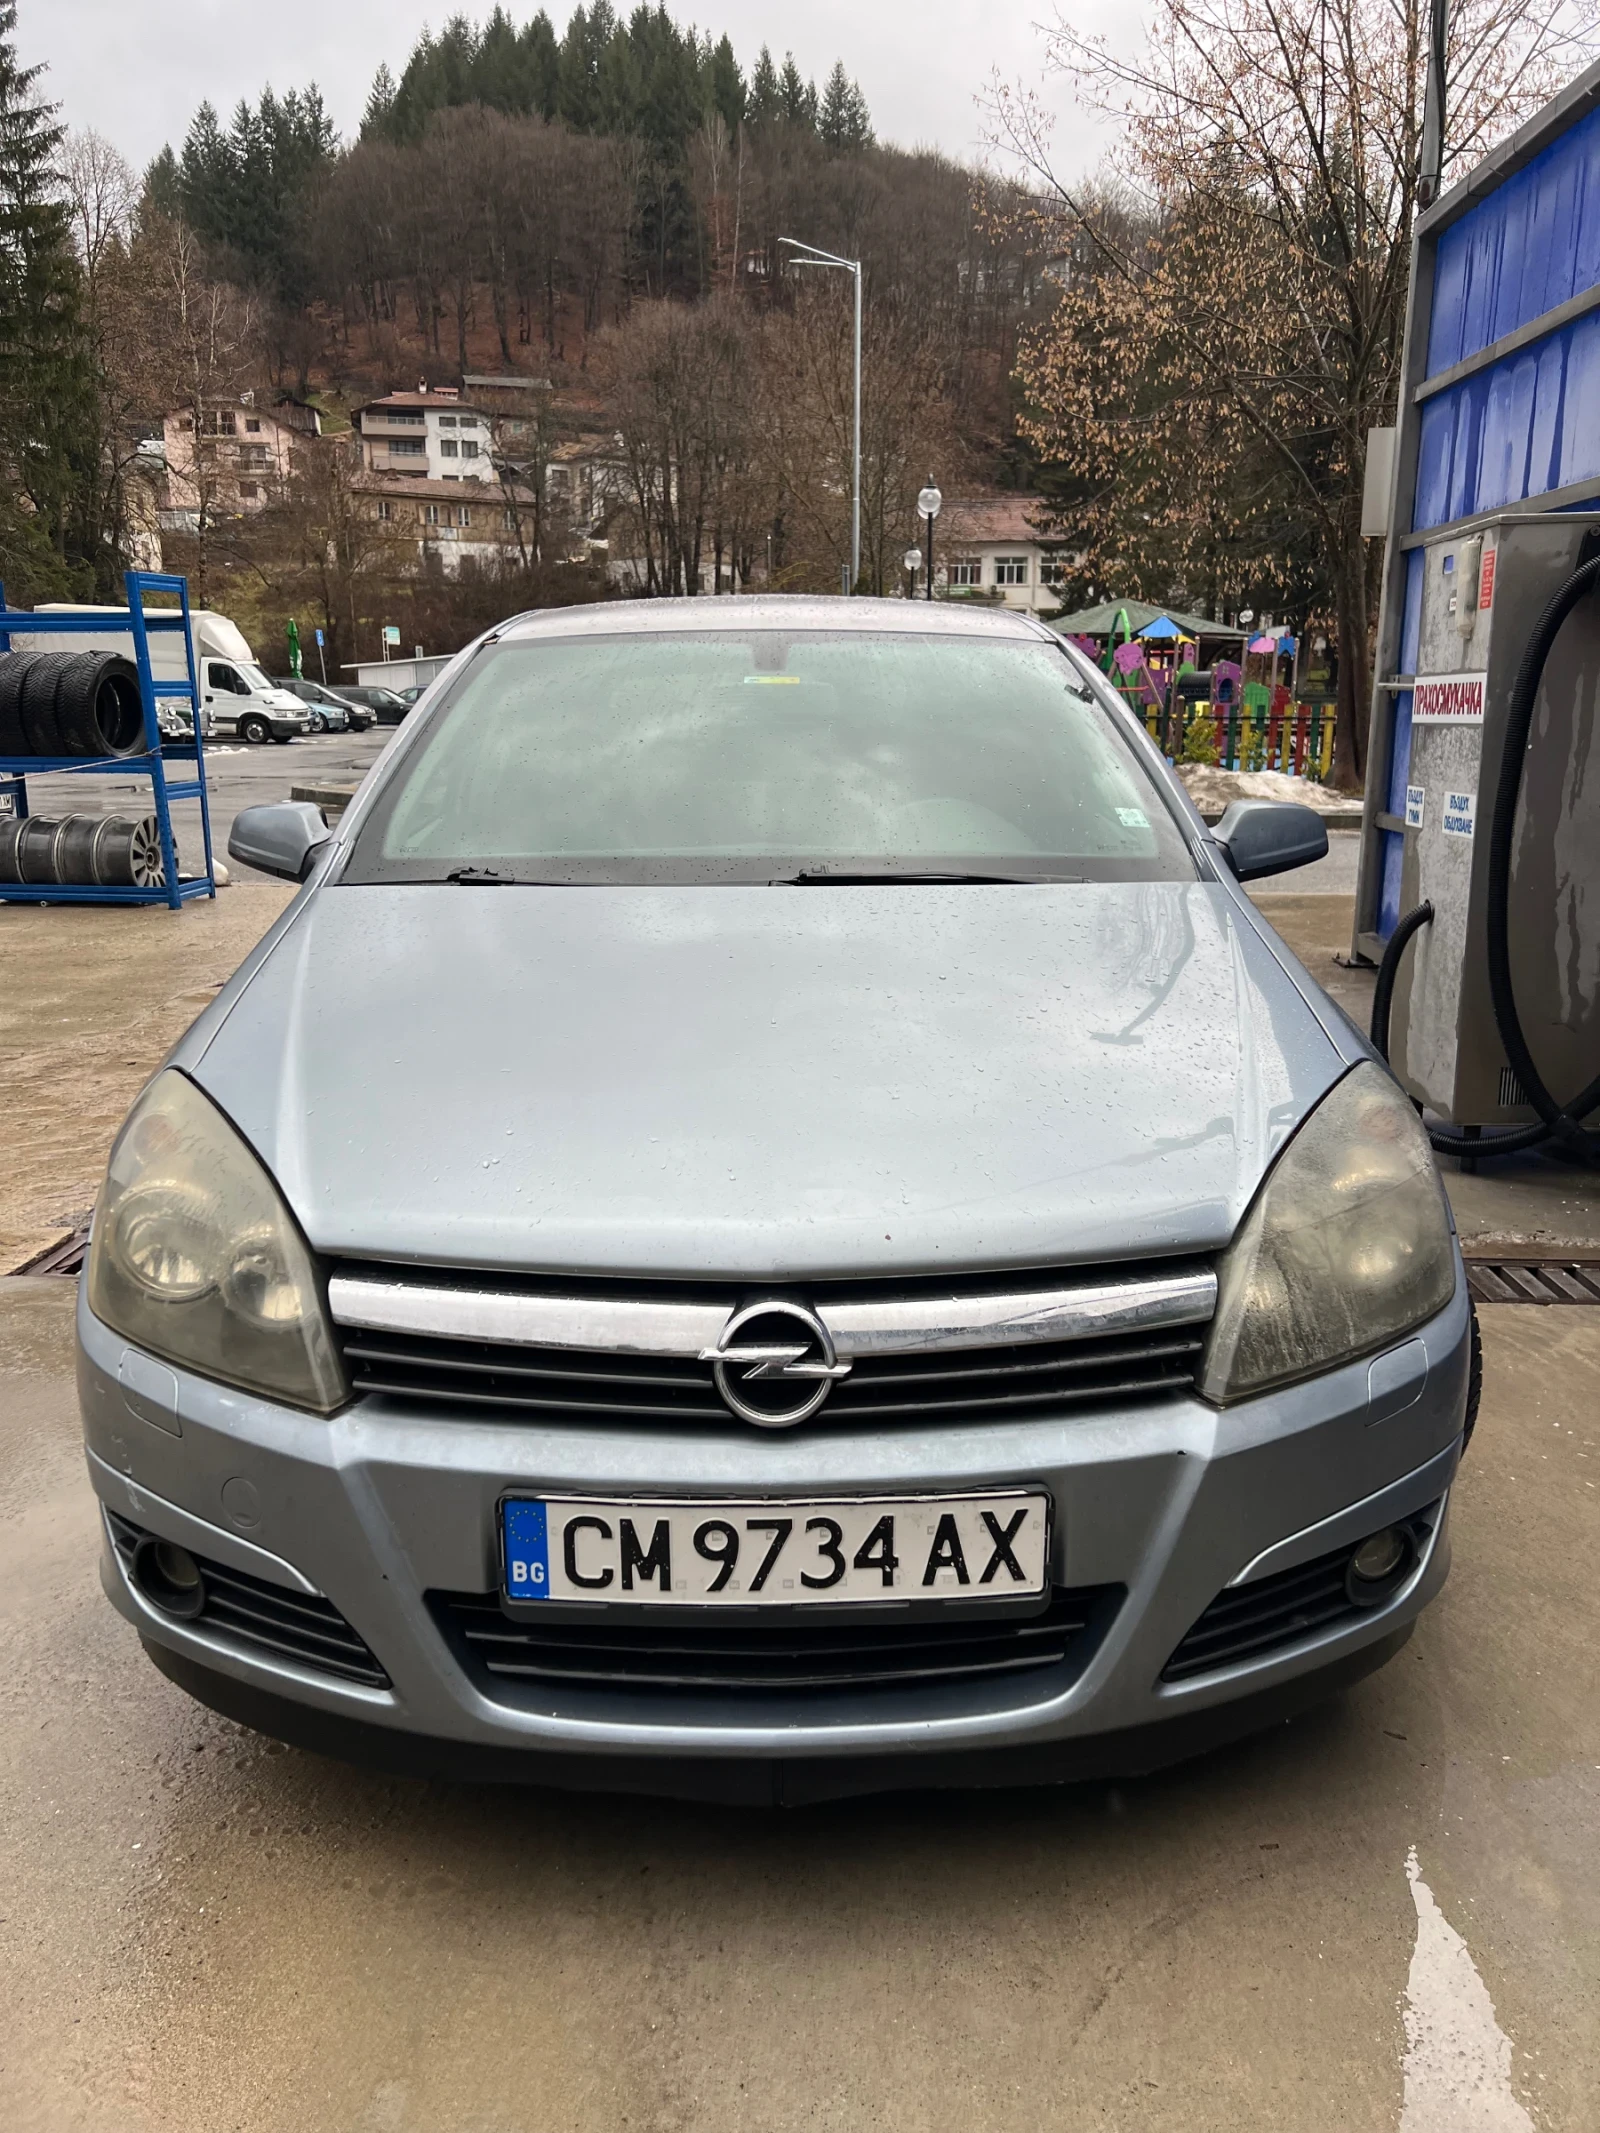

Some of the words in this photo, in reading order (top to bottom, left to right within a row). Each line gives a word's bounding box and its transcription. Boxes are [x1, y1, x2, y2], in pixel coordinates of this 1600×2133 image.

[1414, 682, 1482, 715] ПРАХОСМУКАЧКА
[1450, 795, 1470, 812] ВЪЗДУХ
[1444, 815, 1473, 834] ОБДУХВАНЕ
[563, 1515, 671, 1592] CM
[693, 1515, 899, 1592] 9734
[922, 1508, 1029, 1586] AX
[512, 1561, 545, 1584] BG
